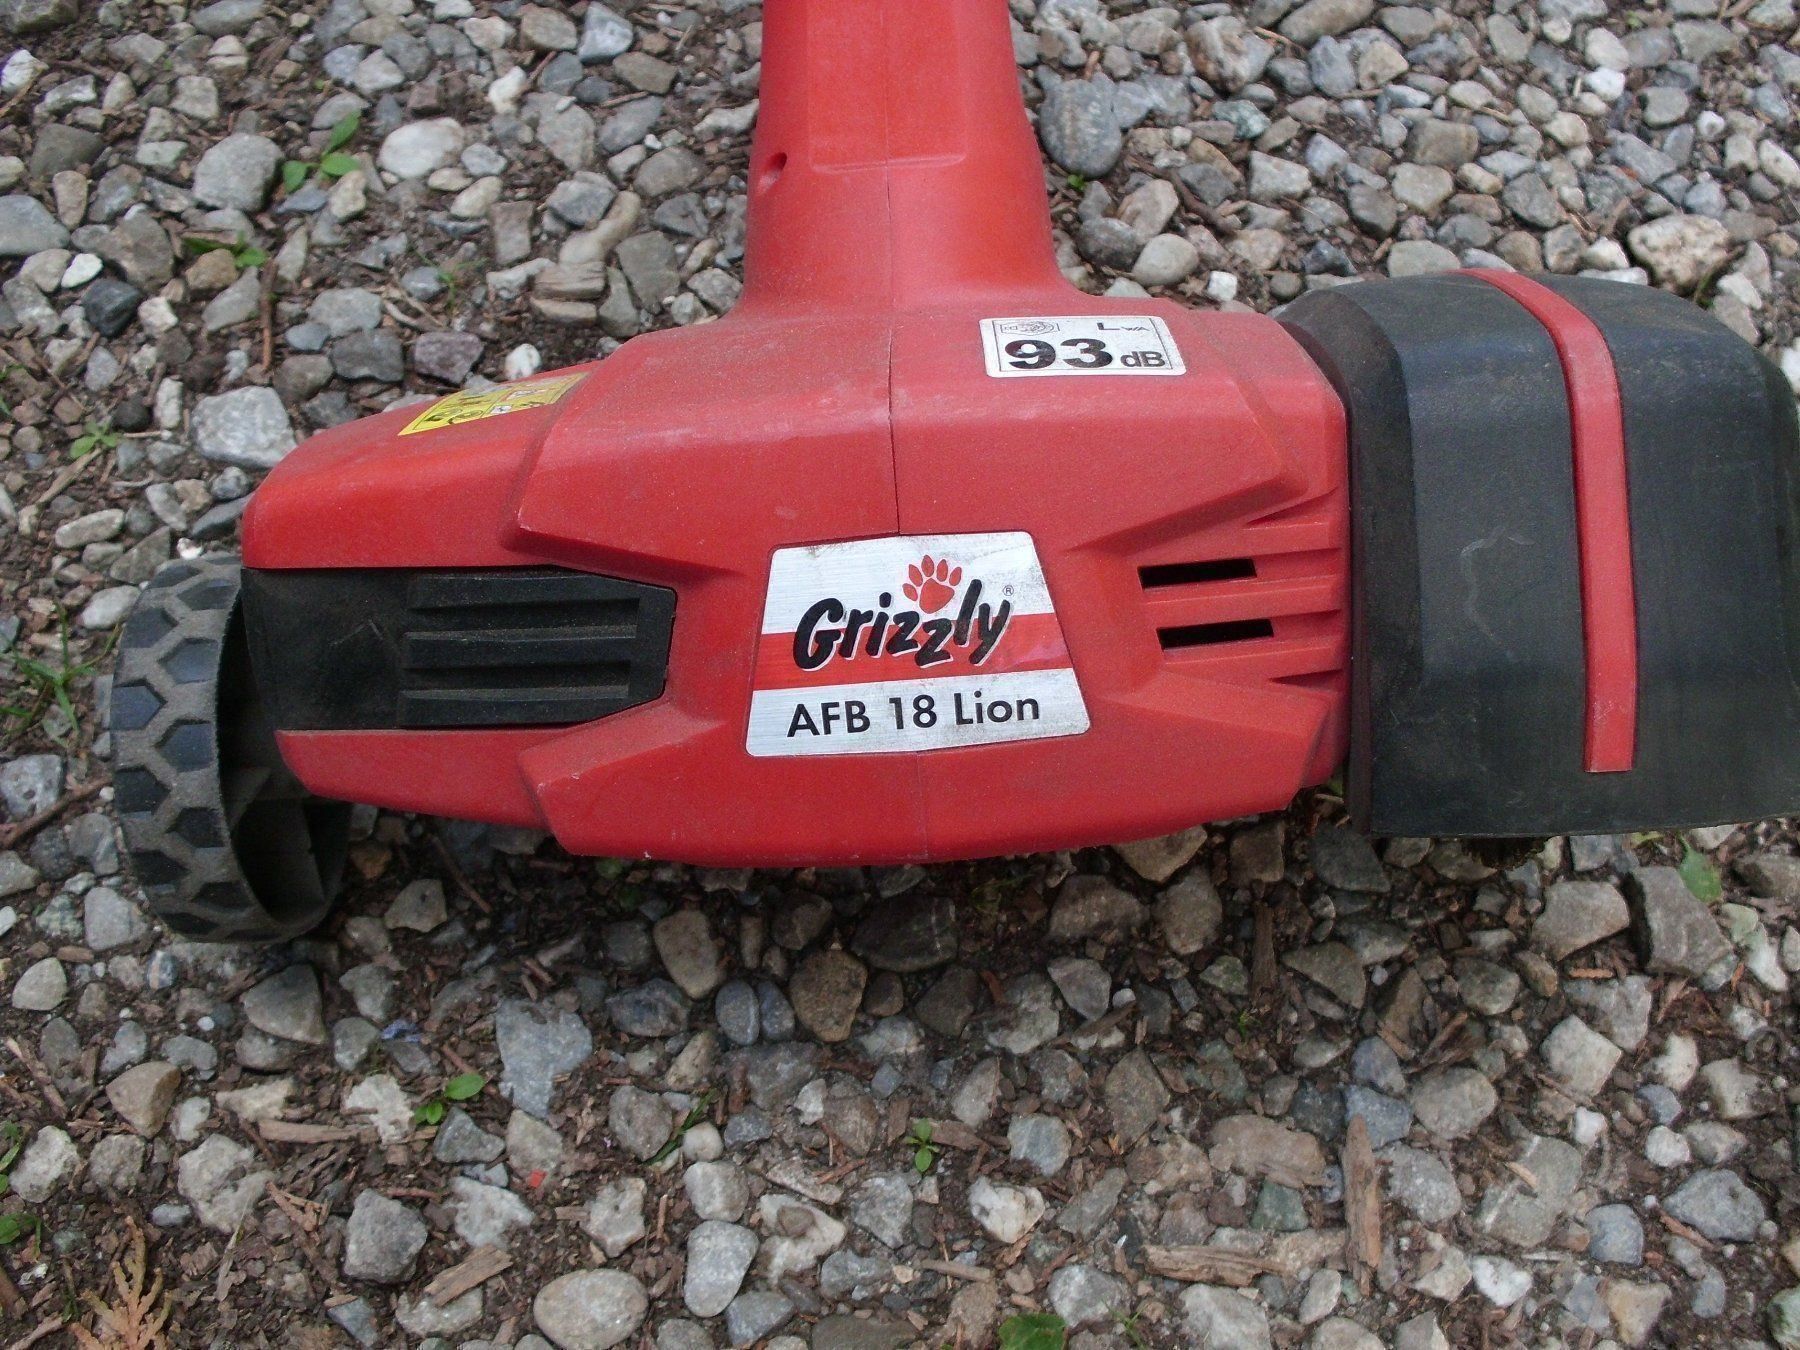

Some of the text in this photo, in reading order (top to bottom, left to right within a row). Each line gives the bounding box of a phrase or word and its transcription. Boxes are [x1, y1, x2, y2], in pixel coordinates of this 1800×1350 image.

[1004, 338, 1166, 369] 93 dB
[793, 578, 1011, 671] Grizzly
[786, 690, 1040, 738] AFB 18 Lion
